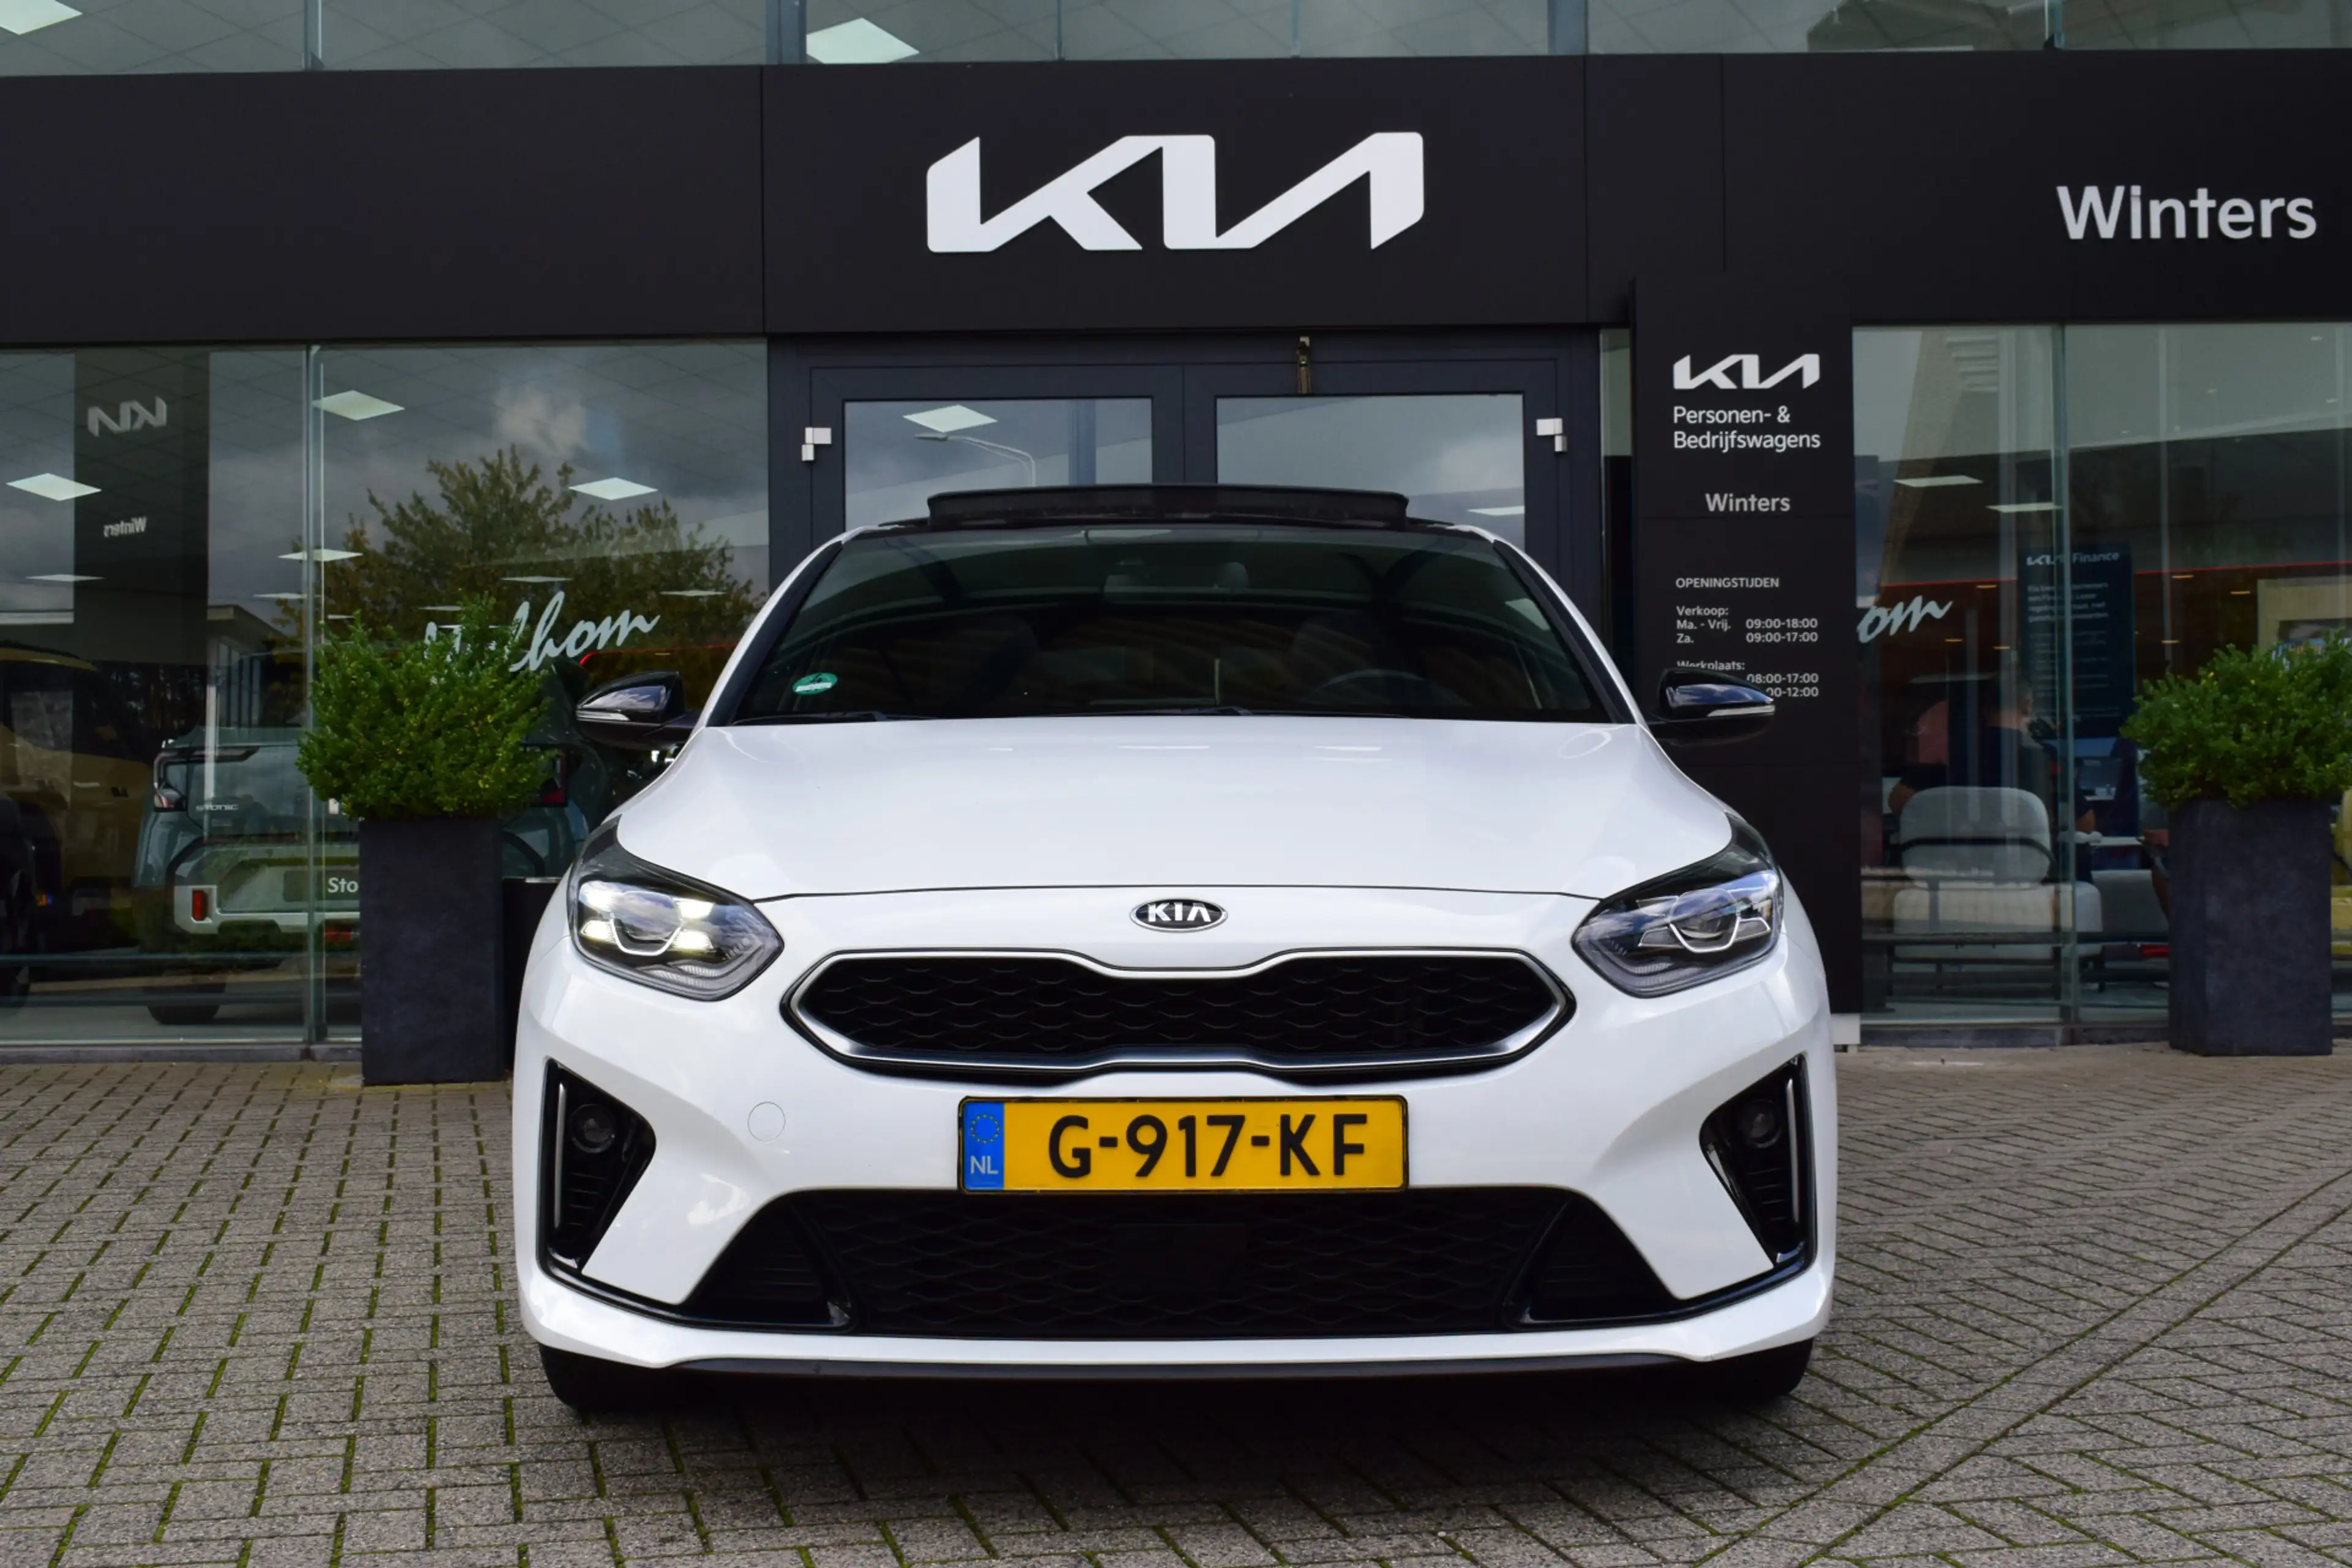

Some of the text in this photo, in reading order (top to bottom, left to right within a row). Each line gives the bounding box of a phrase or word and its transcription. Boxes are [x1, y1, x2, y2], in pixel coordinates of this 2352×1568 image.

[927, 132, 1424, 252] KIA
[2056, 185, 2317, 239] Winters
[1673, 353, 1820, 389] KIA
[1673, 405, 1790, 423] Personen- &
[1673, 430, 1821, 453] Bedrijfswagens
[1705, 493, 1790, 512] Winters
[2072, 552, 2120, 564] Finance
[1676, 578, 1779, 588] OPENINGSTIJDEN
[1676, 606, 1728, 617] Verkoop:
[1676, 620, 1697, 630] Ma.
[1708, 619, 1732, 631] Vrij.
[1746, 619, 1818, 629] 09:00-18:00
[1676, 632, 1818, 643] Za. 09:00-17:00
[1746, 673, 1819, 684] 08:00-17:00
[1766, 687, 1819, 697] 00-12:00
[328, 877, 359, 893] Sto
[1147, 902, 1212, 922] KIA
[970, 1114, 1368, 1178] NL G-917-KF
